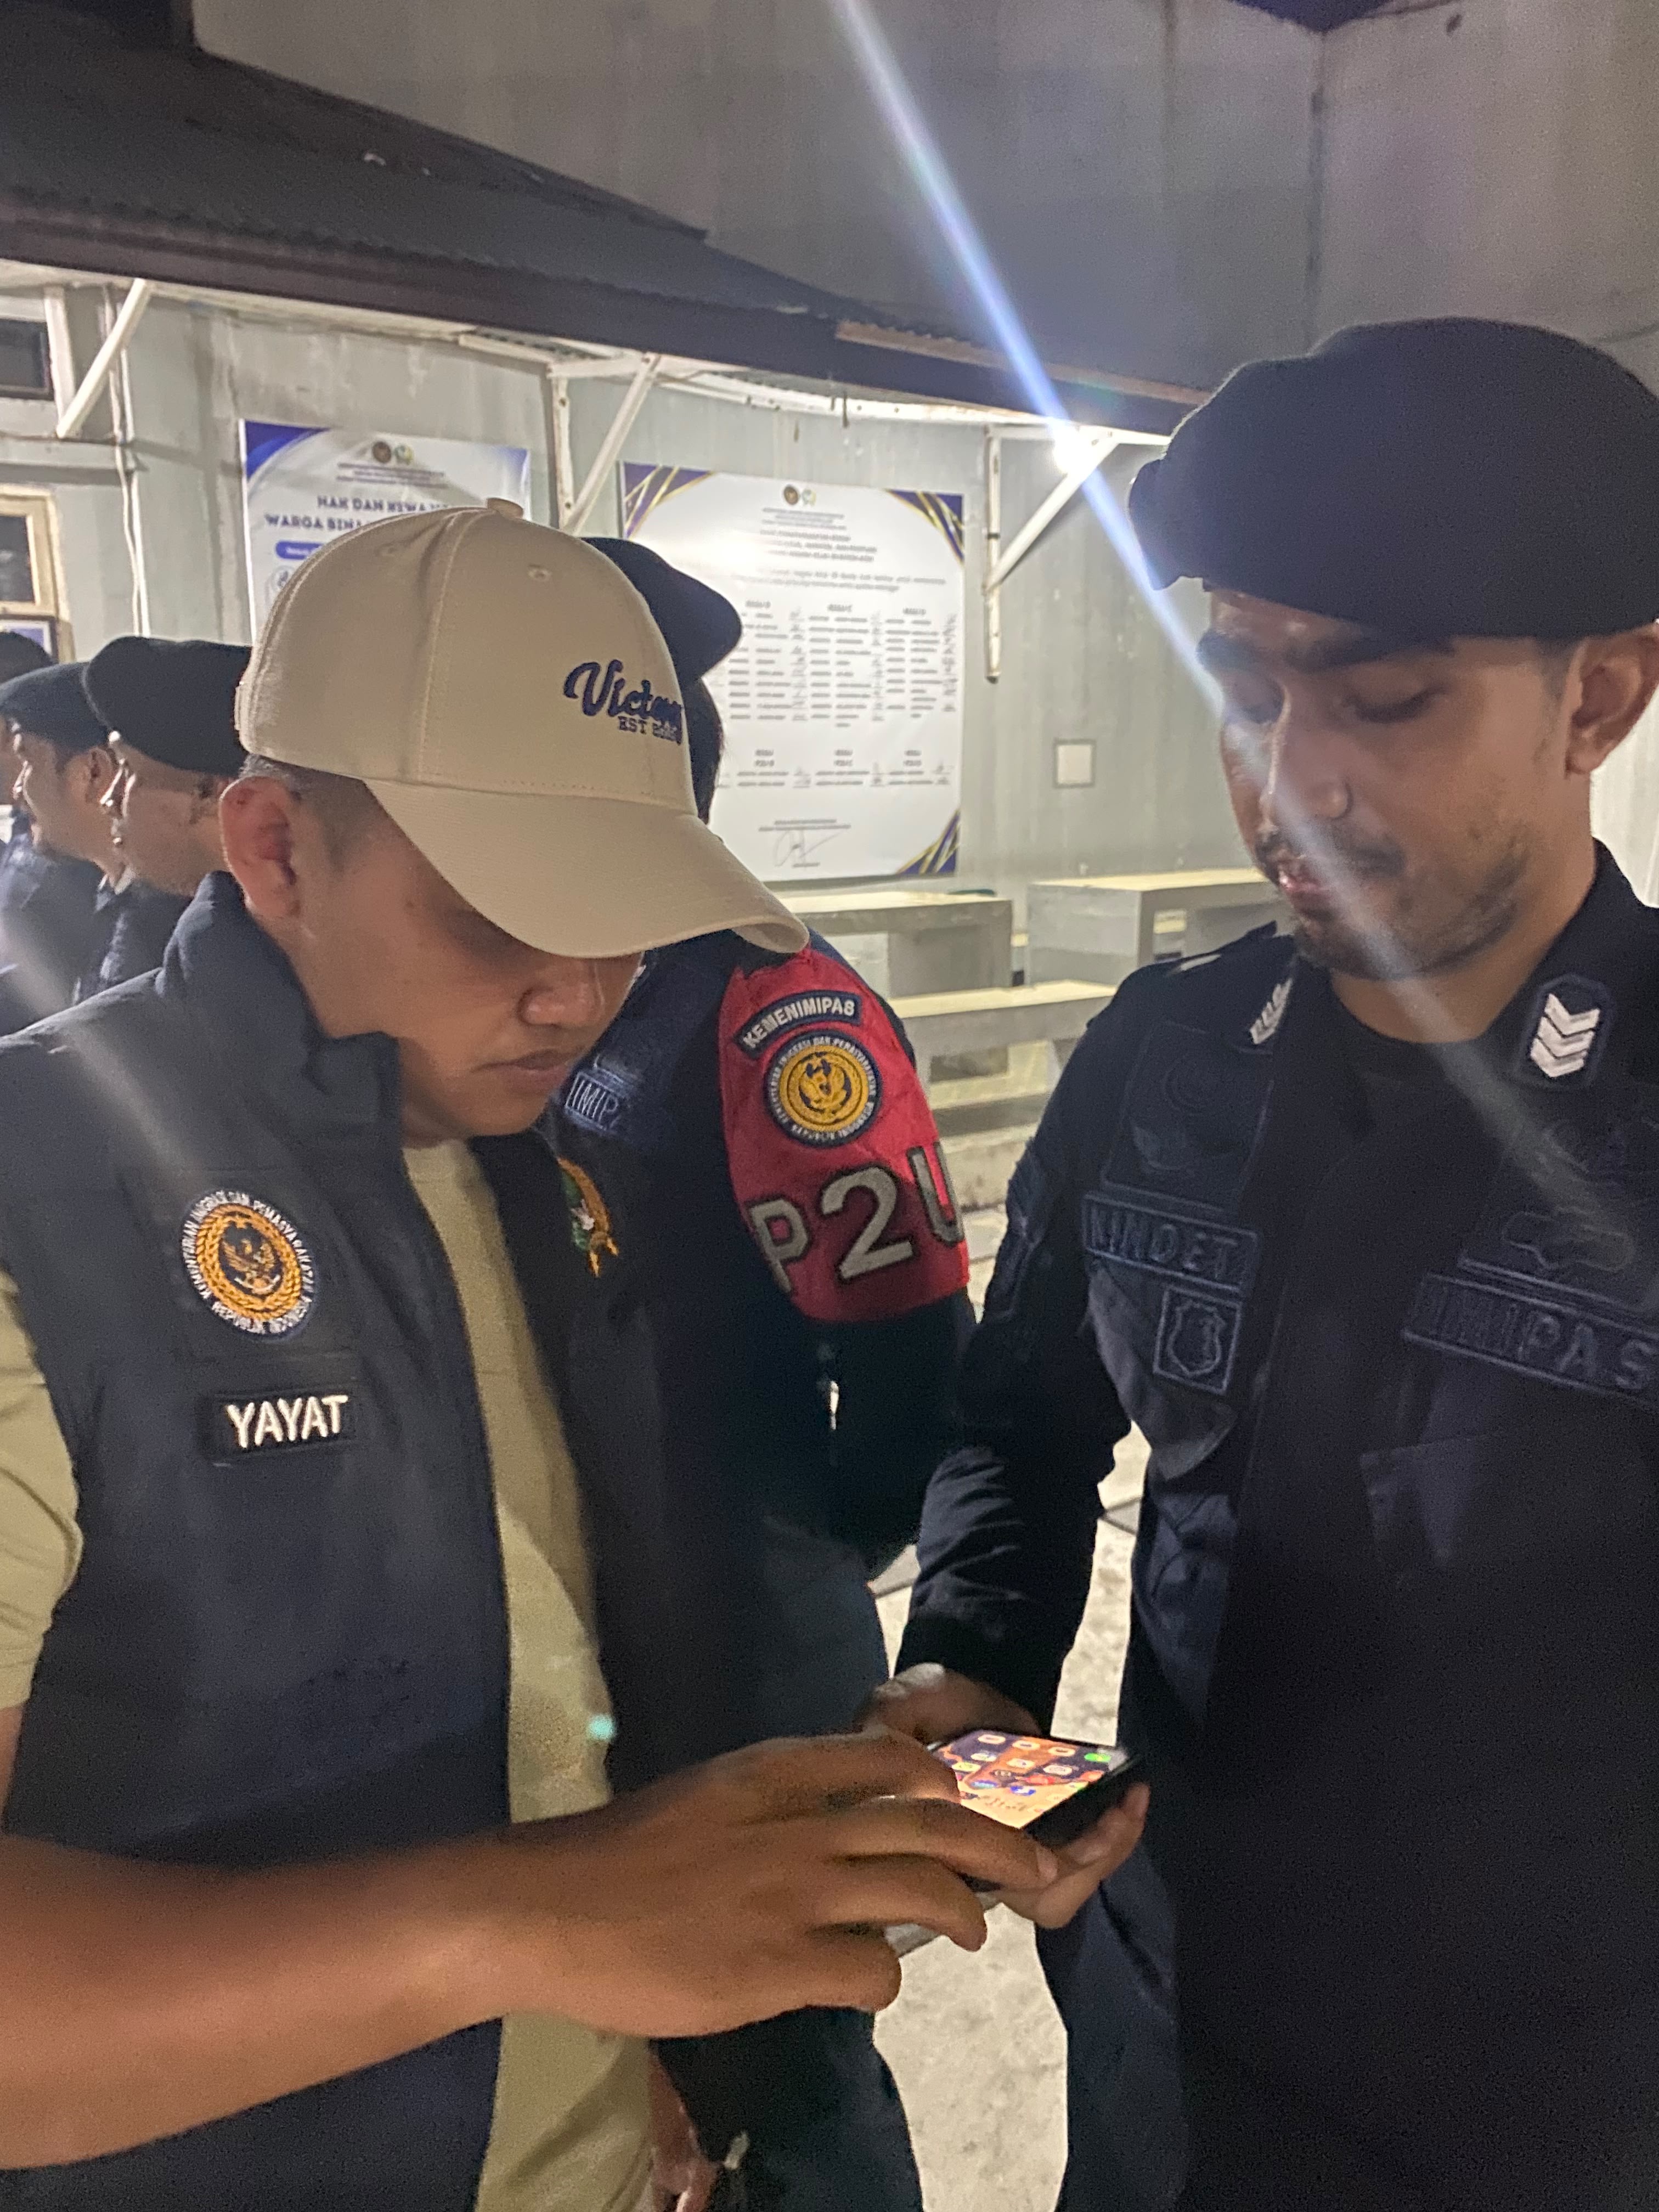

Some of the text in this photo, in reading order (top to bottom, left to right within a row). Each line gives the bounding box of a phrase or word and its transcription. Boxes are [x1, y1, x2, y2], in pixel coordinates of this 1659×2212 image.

[317, 495, 348, 510] HAK
[353, 498, 384, 511] DAN
[265, 513, 324, 529] WARGA
[749, 1142, 964, 1293] P2U
[226, 1395, 348, 1449] YAYAT
